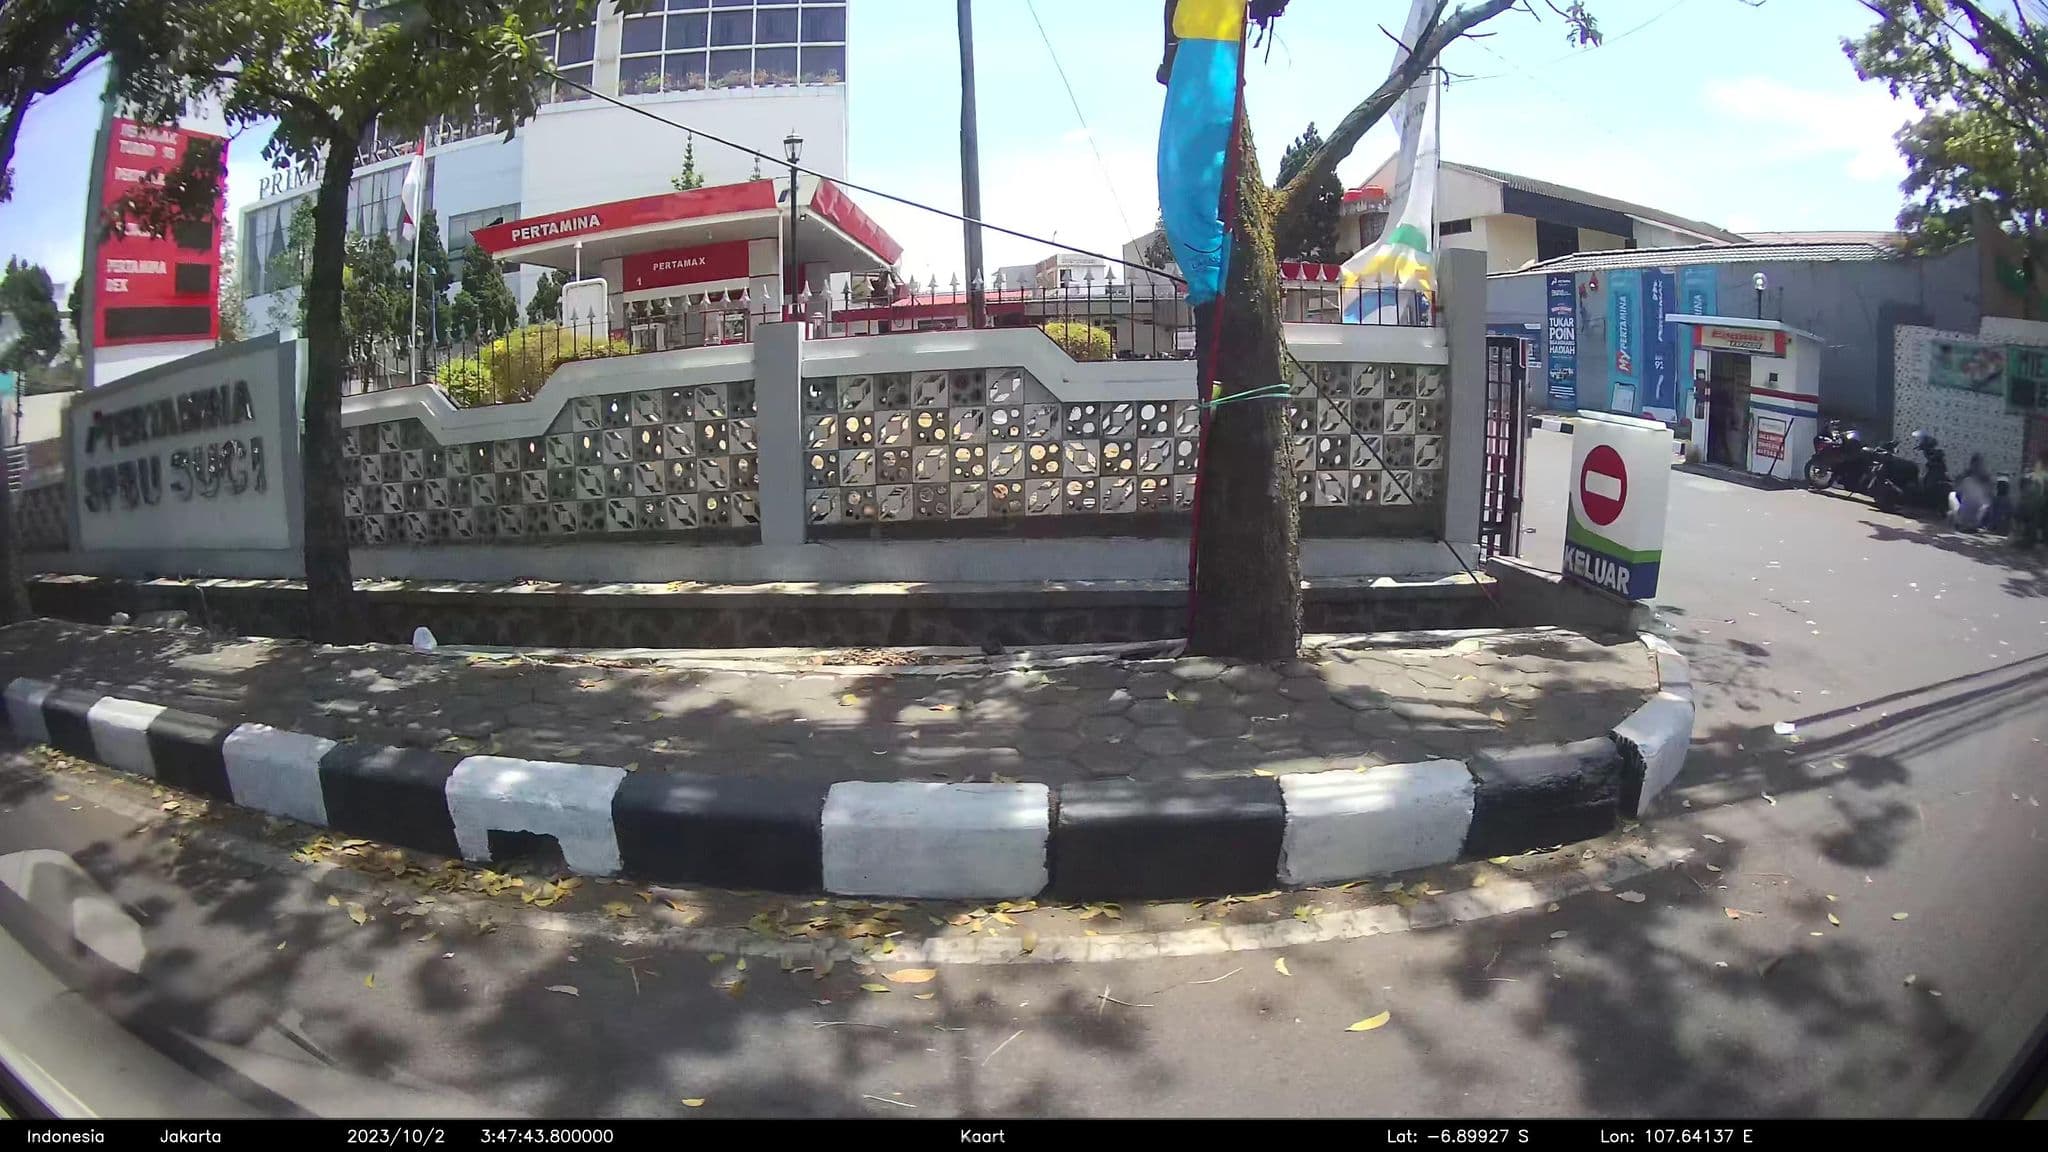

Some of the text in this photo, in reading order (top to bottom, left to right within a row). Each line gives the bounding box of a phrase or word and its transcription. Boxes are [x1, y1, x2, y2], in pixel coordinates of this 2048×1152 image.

[511, 213, 602, 242] PERTAMINA
[653, 256, 706, 272] PERTAMAX
[1549, 317, 1575, 328] TUKAR
[1549, 327, 1575, 340] POIN
[1563, 544, 1631, 595] KELUAR
